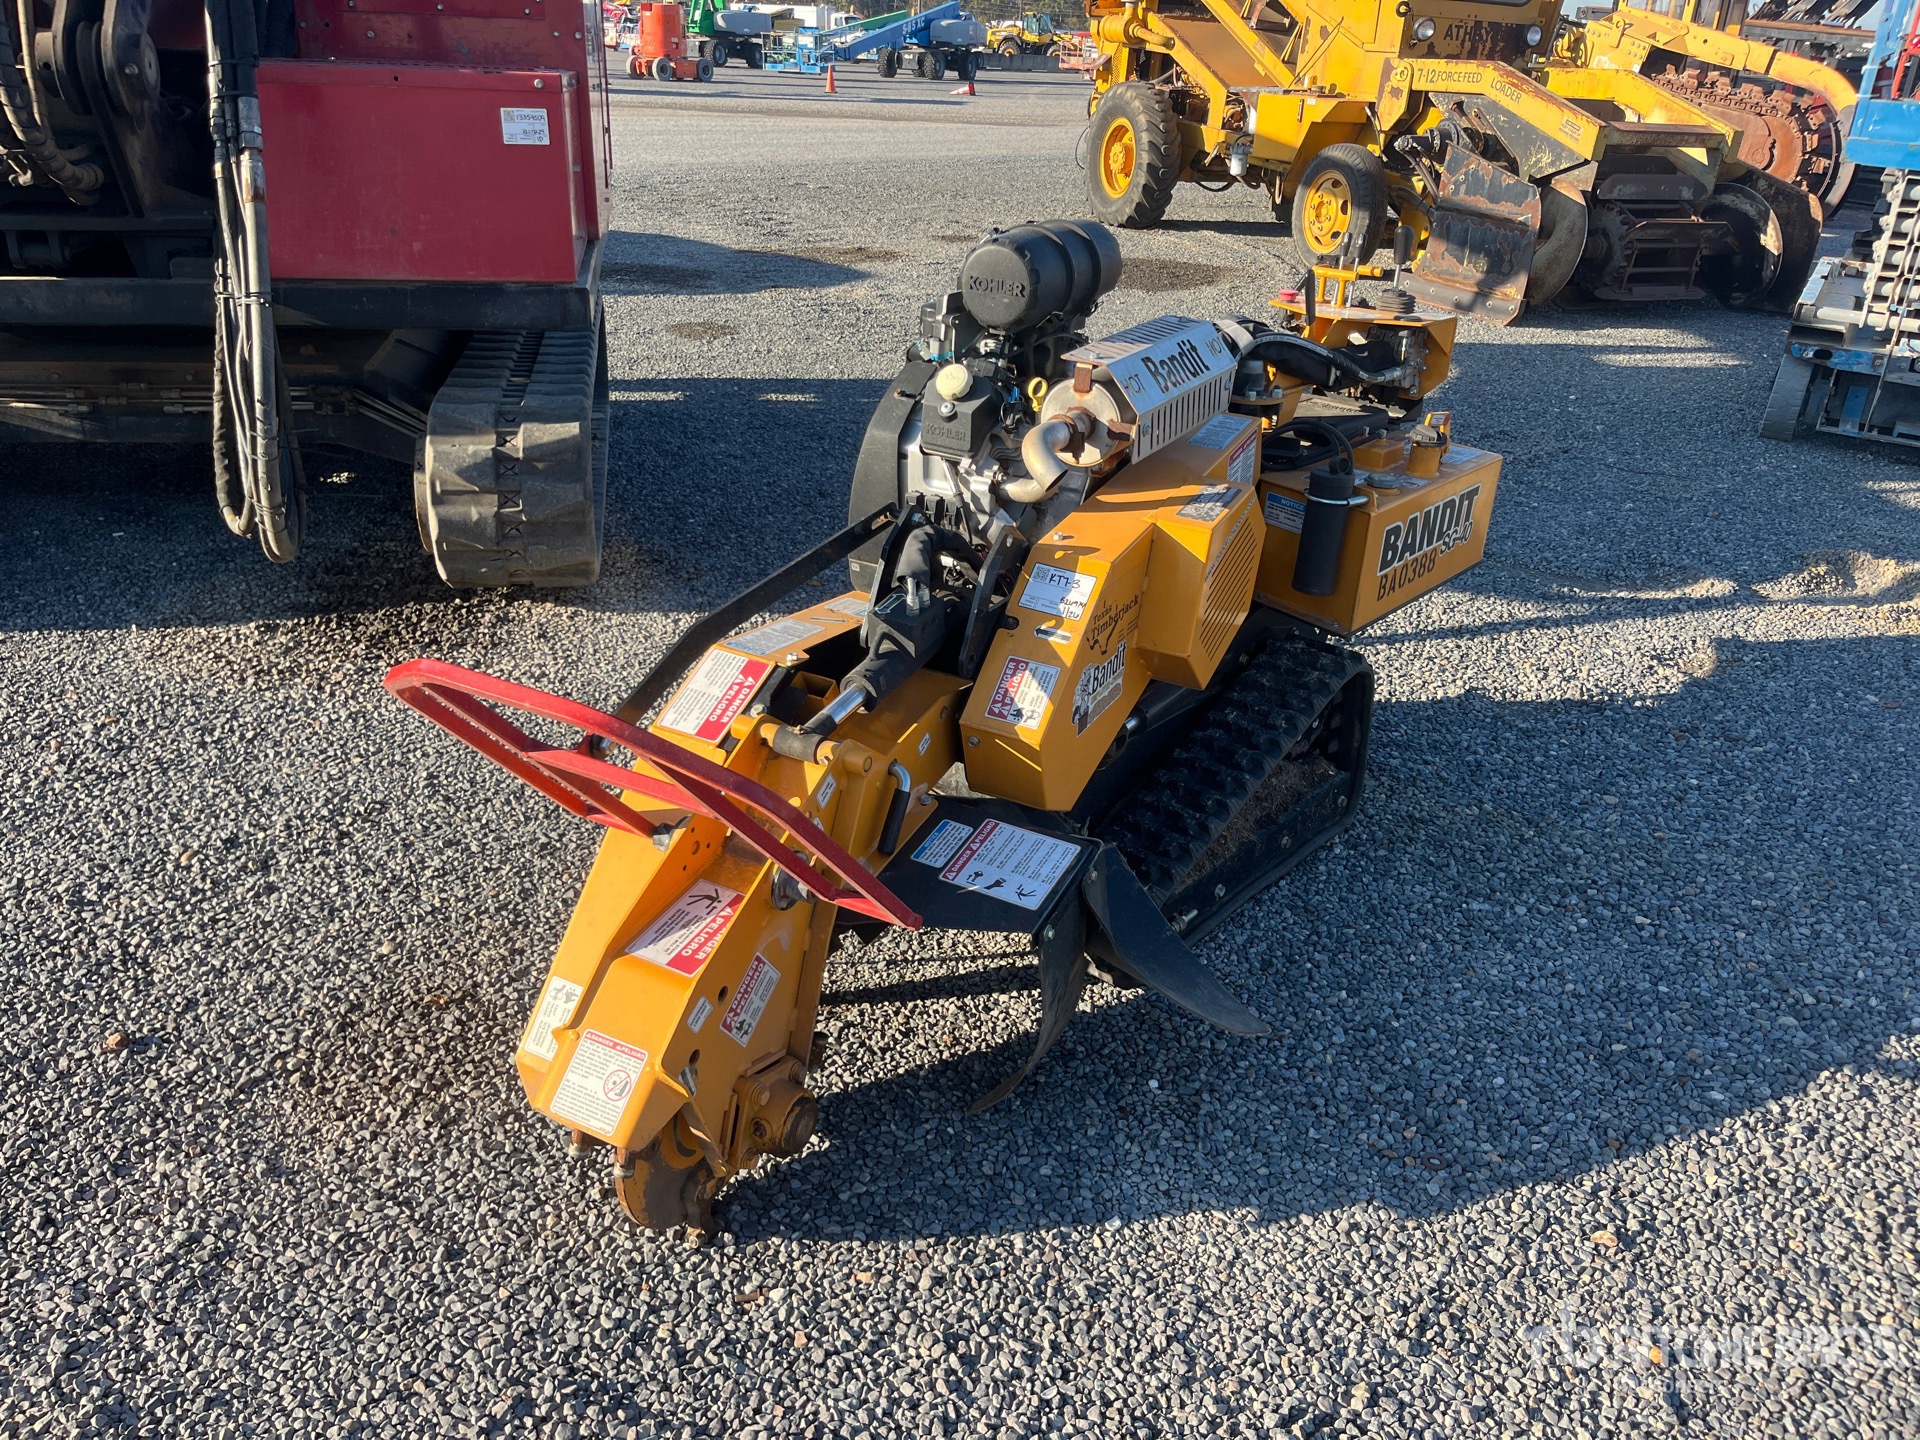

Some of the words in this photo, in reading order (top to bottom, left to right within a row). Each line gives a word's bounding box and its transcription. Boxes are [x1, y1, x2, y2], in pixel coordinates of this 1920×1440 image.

[917, 16, 925, 29] XC
[1490, 76, 1522, 104] LOADER
[970, 276, 1026, 298] KOHLER
[1120, 373, 1146, 398] HOT
[1141, 339, 1211, 394] Bandit
[926, 423, 966, 440] KOHLER
[1280, 498, 1304, 510] NOTICE
[1378, 484, 1481, 574] BANDIT
[1377, 548, 1437, 602] BA0388
[1091, 594, 1139, 640] Timberjack
[1093, 606, 1112, 625] Texas
[994, 661, 1016, 701] DANGER
[1003, 662, 1027, 704] PELIGRO
[1092, 642, 1126, 694] Bandit
[707, 684, 740, 722] PELIGRO
[719, 687, 750, 723] DANGER
[950, 849, 972, 871] DANGER
[974, 821, 996, 842] PELIGRO
[679, 916, 725, 957] PELIGRO
[694, 924, 730, 960] ANGER
[731, 959, 758, 1009] DANGER
[735, 961, 764, 1013] PELIGRO
[590, 1033, 614, 1047] DANGER
[620, 1045, 646, 1060] PELIGRO
